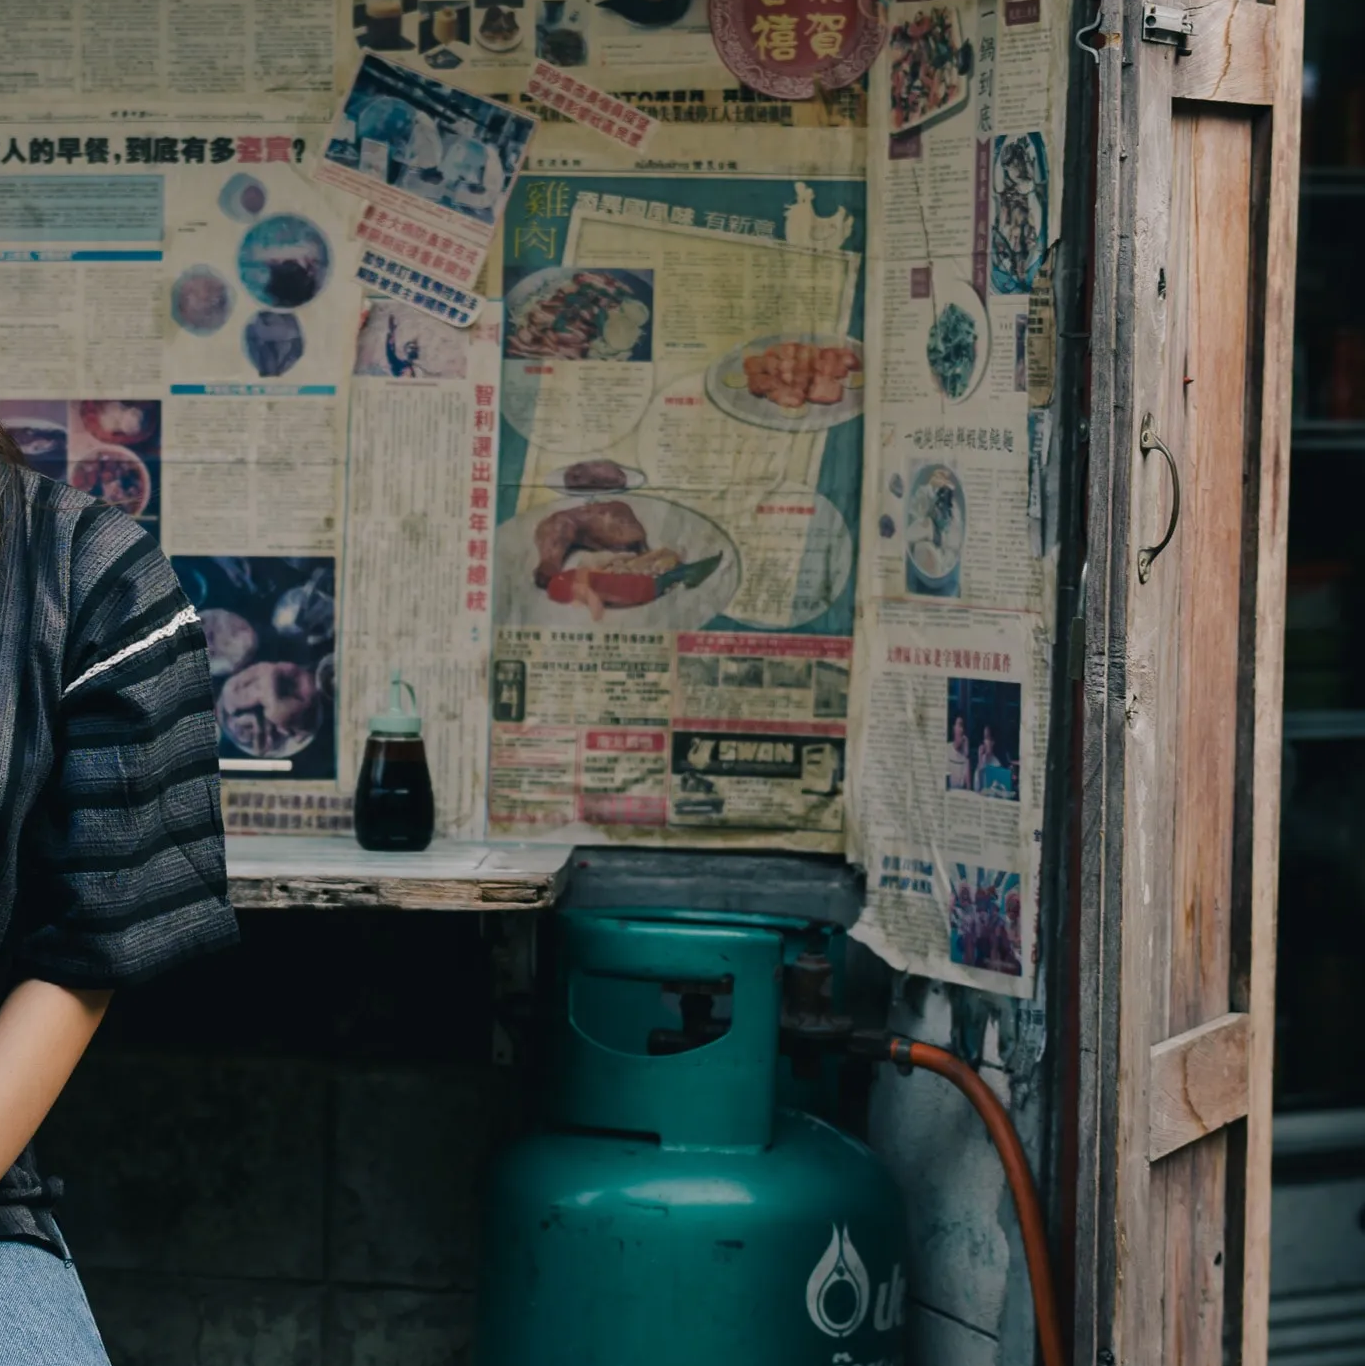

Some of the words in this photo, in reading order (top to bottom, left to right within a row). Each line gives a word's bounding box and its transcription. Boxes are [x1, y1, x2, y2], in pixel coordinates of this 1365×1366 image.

[514, 179, 571, 260] 雞肉
[466, 384, 494, 613] 智利選出最年輕總統
[719, 740, 794, 763] SWAN
